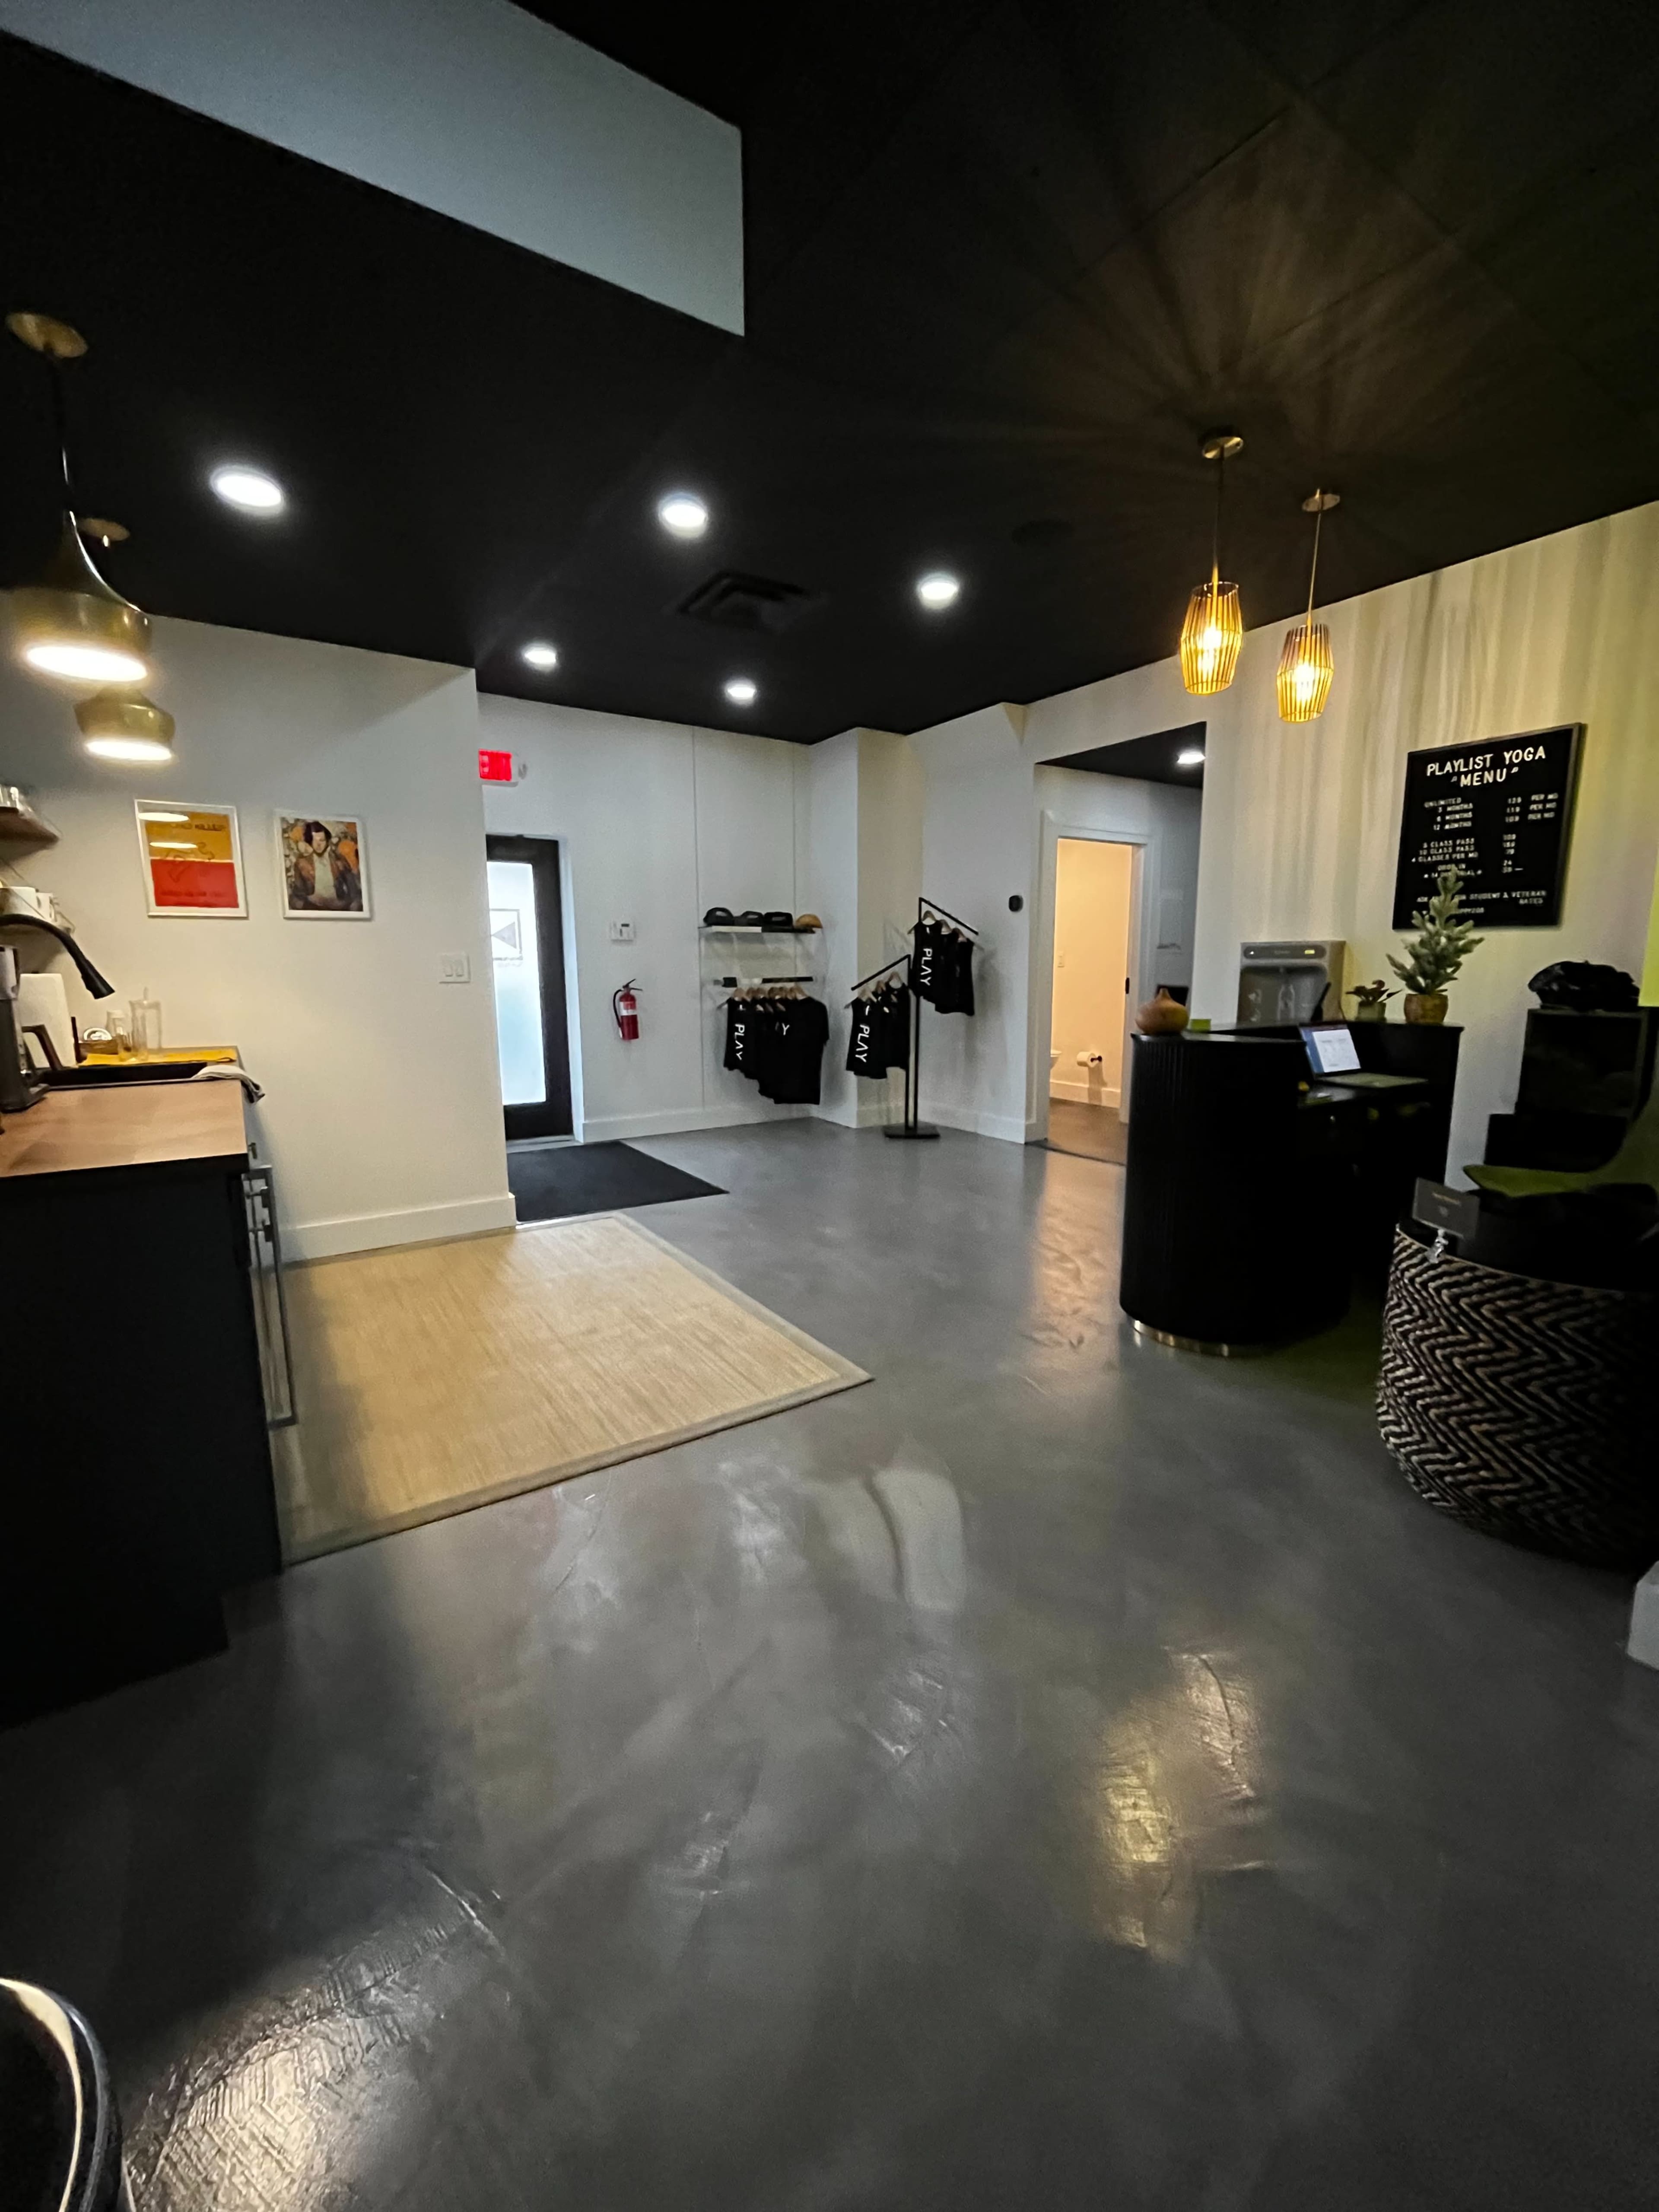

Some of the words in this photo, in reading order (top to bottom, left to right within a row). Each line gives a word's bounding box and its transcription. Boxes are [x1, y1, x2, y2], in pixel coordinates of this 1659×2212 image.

[1427, 754, 1494, 776] PLAYLIST
[1503, 746, 1545, 765] YOGA
[1460, 768, 1506, 787] MENU
[920, 948, 933, 986] PLAY
[734, 1023, 745, 1061] PLAY
[855, 1024, 870, 1063] PLAY
